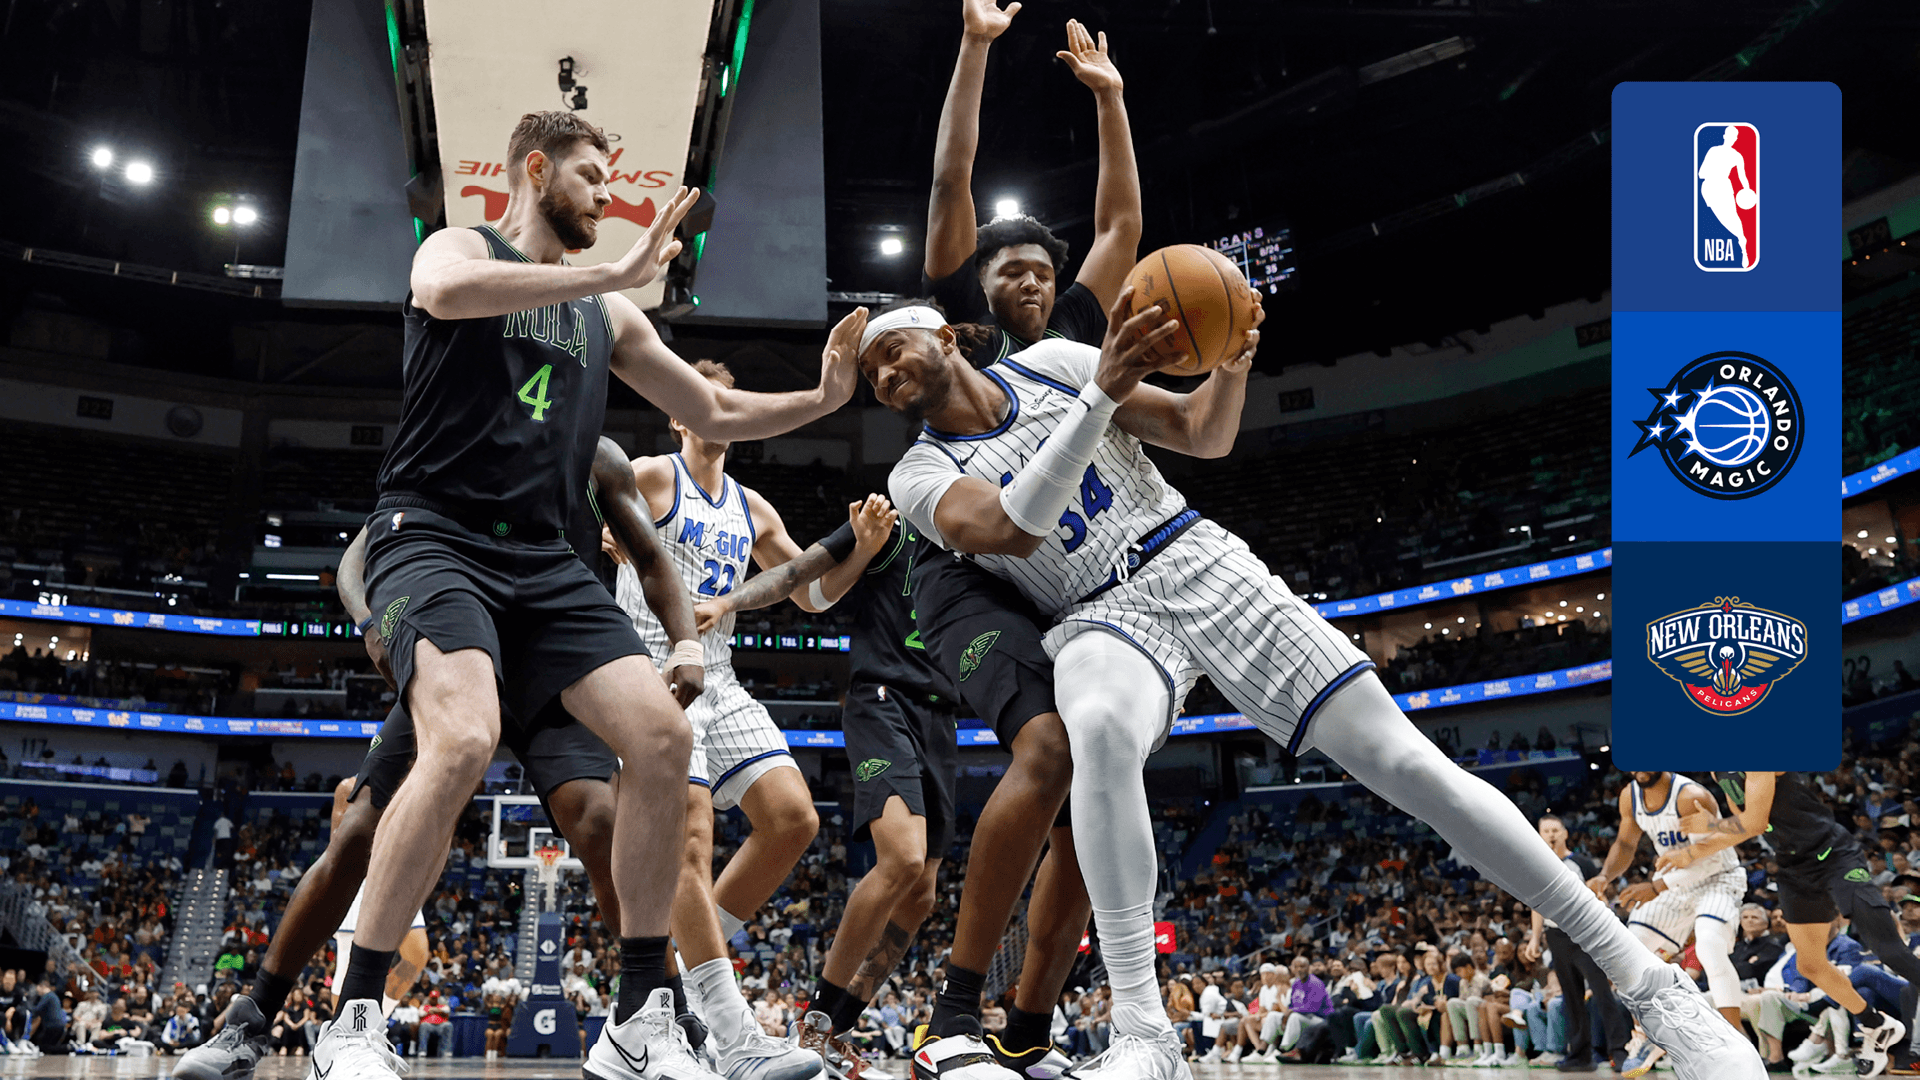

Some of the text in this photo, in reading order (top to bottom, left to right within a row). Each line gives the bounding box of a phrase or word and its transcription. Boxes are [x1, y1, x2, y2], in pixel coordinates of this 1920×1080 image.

[455, 160, 673, 188] SMHIE
[503, 303, 588, 368] NOLA
[517, 363, 553, 421] 4
[1030, 388, 1054, 412] Disney
[697, 559, 736, 597] 22
[807, 638, 814, 647] 2
[533, 1008, 557, 1035] G
